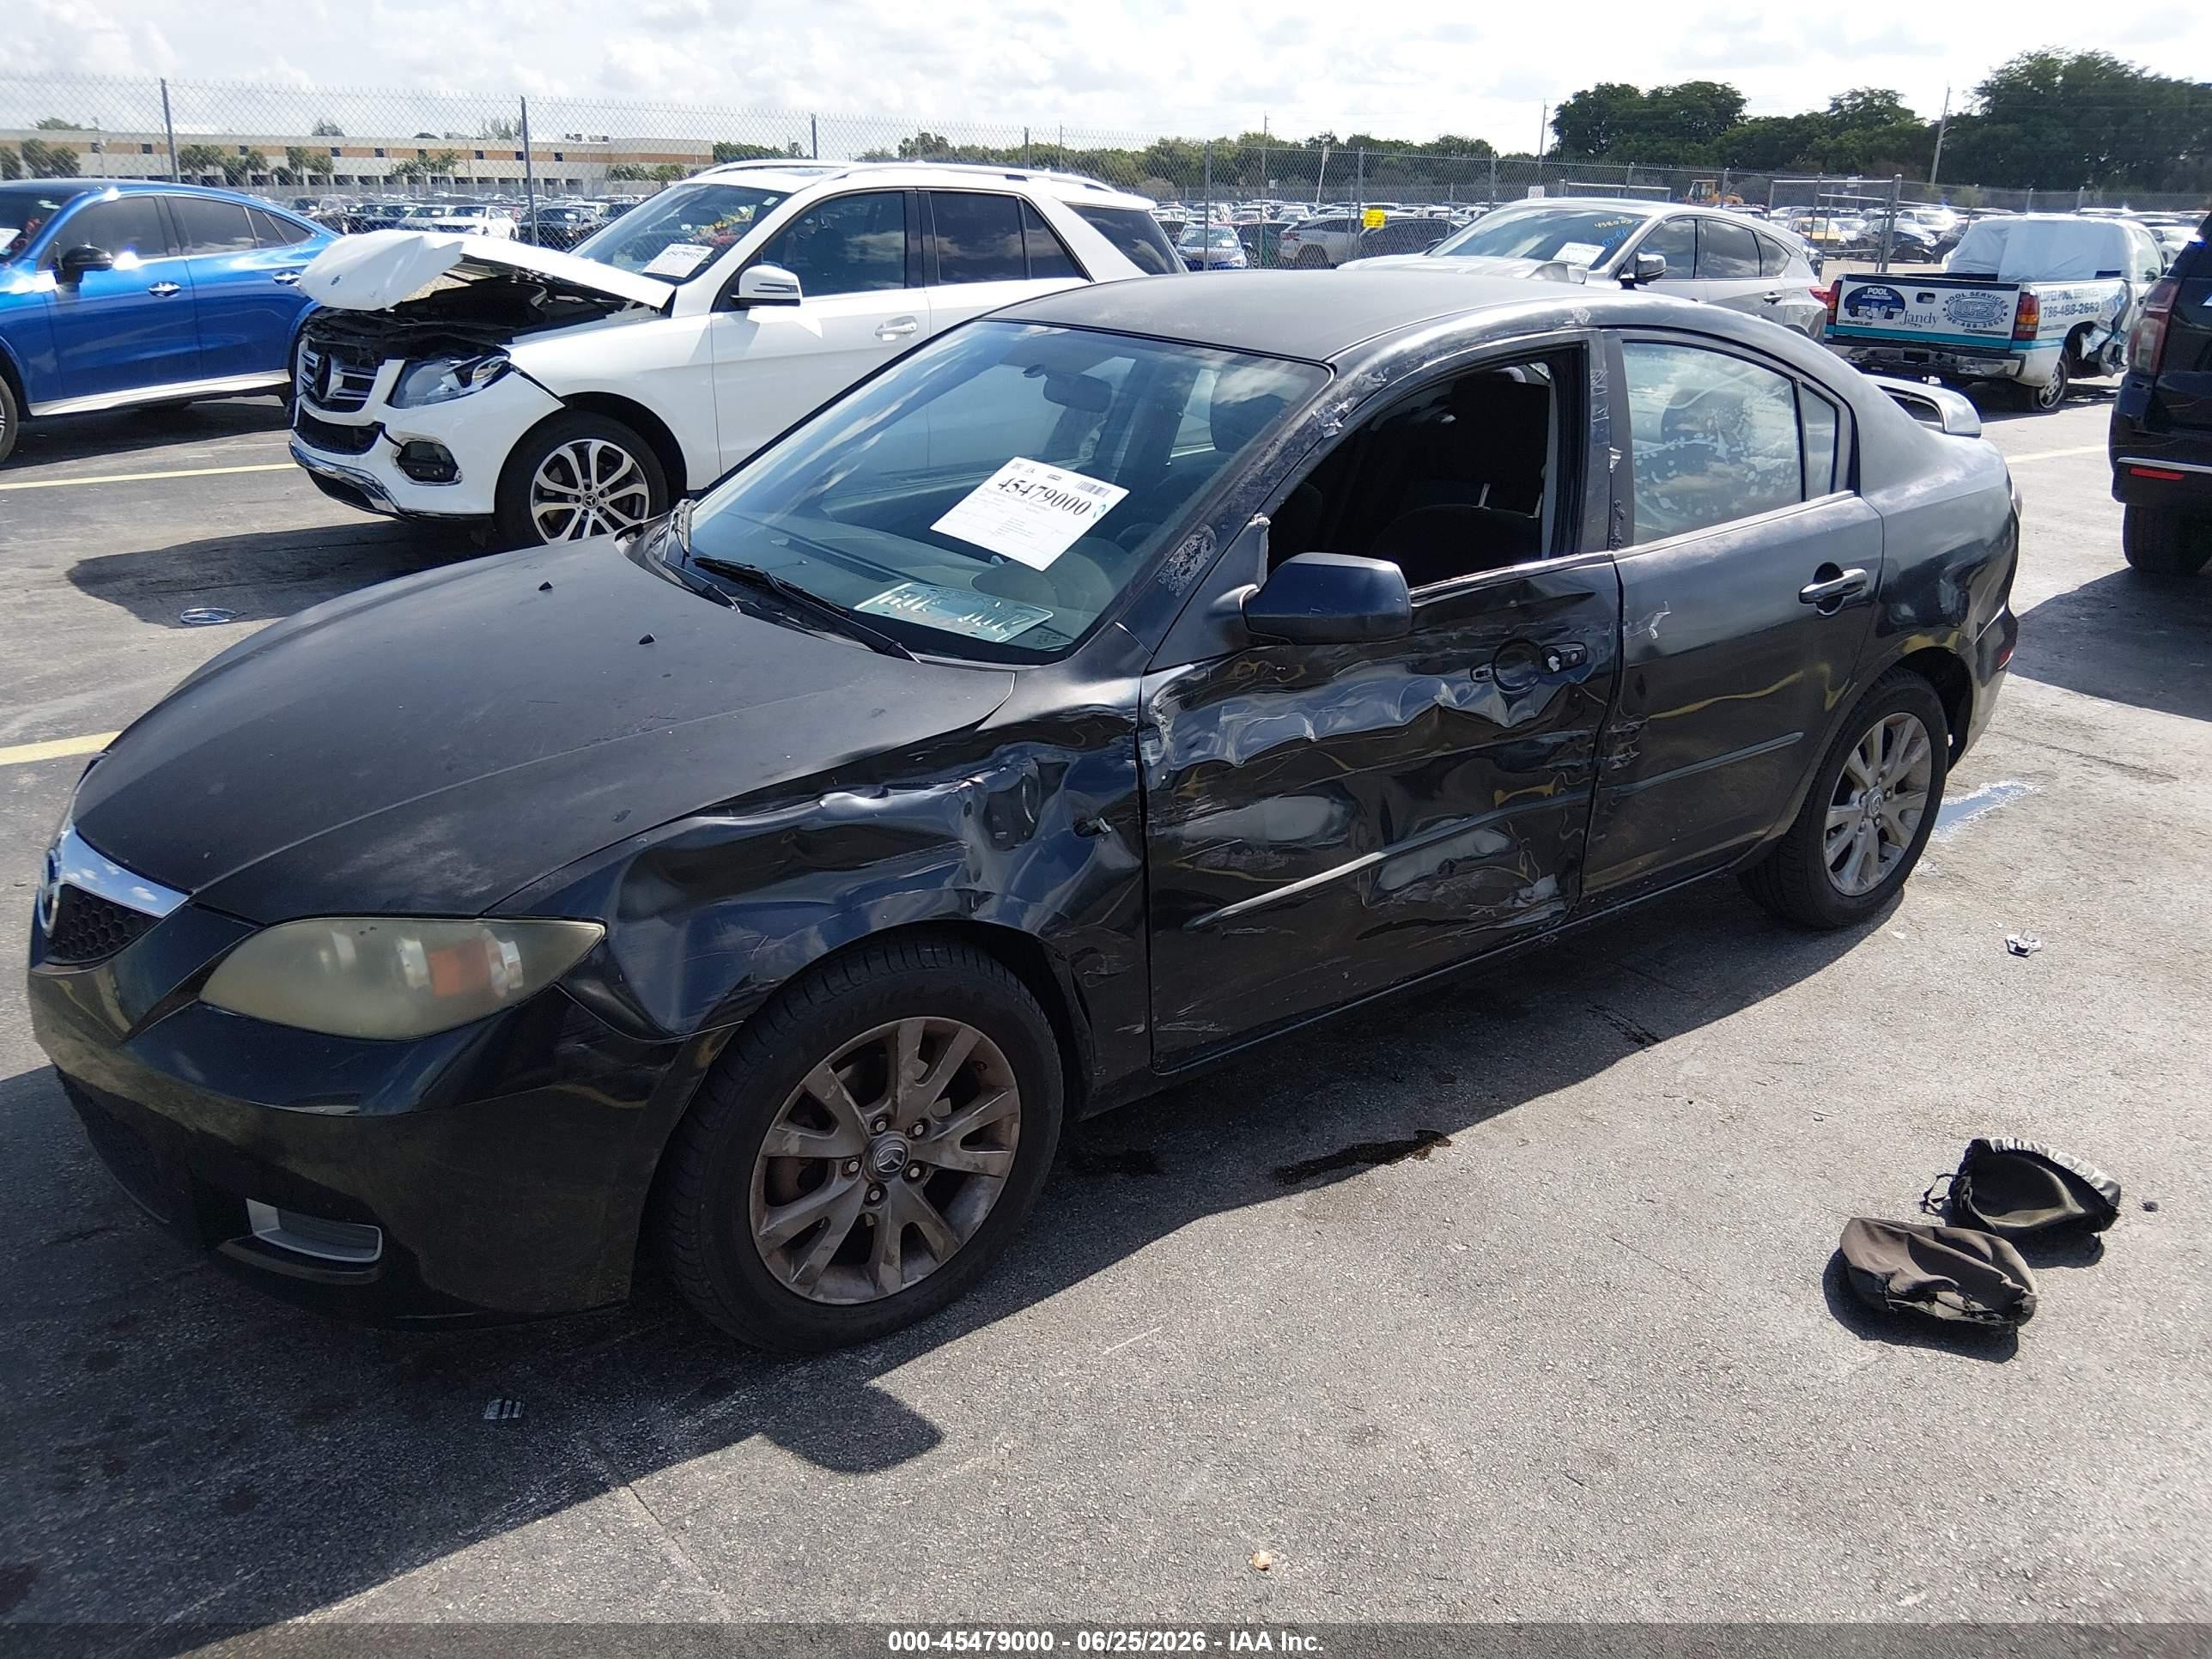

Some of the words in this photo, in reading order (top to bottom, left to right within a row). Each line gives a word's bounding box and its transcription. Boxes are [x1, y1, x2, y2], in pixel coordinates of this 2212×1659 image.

[1867, 287, 1889, 295] POOL
[1944, 292, 1968, 305] POOL
[1970, 291, 2009, 310] SERVICES
[1954, 299, 1999, 317] LOPEZ
[1899, 309, 1939, 328] Jandy
[2043, 301, 2100, 319] 786-488-2662
[997, 477, 1092, 516] 45479000
